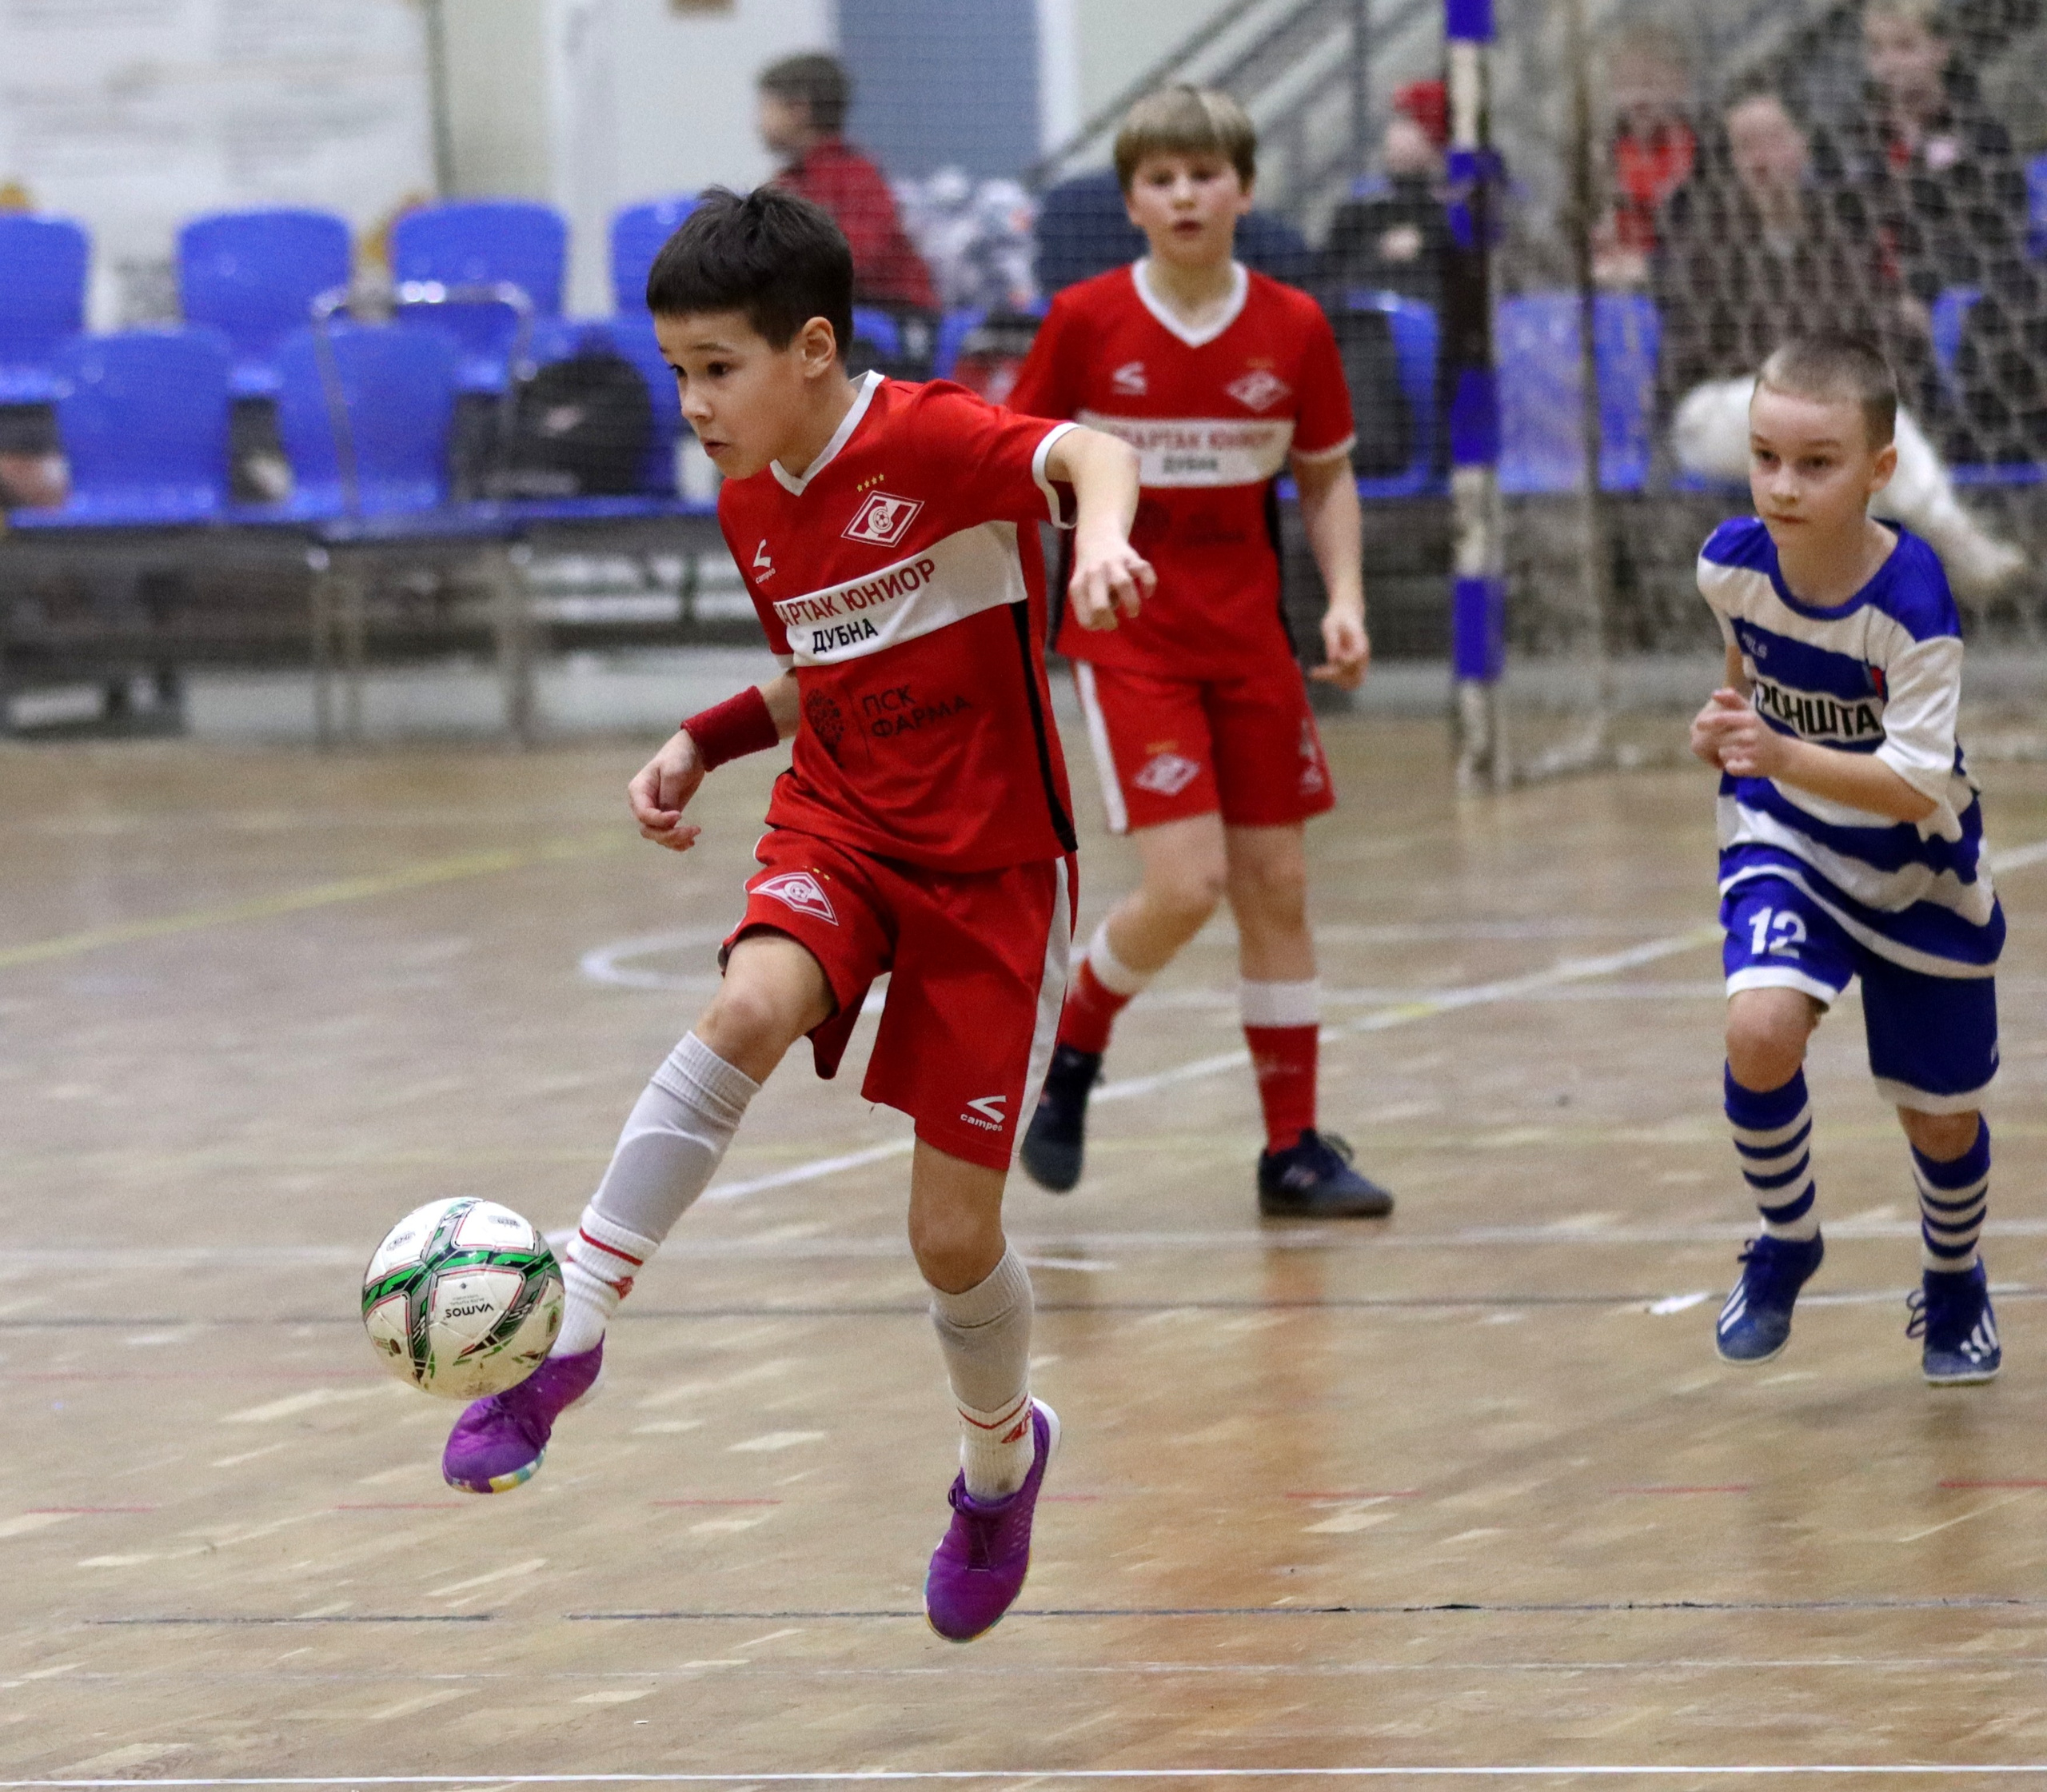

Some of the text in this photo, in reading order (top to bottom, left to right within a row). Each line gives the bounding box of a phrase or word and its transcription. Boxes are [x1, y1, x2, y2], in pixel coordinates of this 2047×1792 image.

[773, 558, 935, 626] АРТАК ЮНИОР
[812, 617, 878, 654] ДУБНА
[862, 684, 916, 717] ПСК
[872, 695, 973, 738] ФАРМА
[1749, 907, 1807, 959] 12
[445, 1303, 494, 1319] VAMOS
